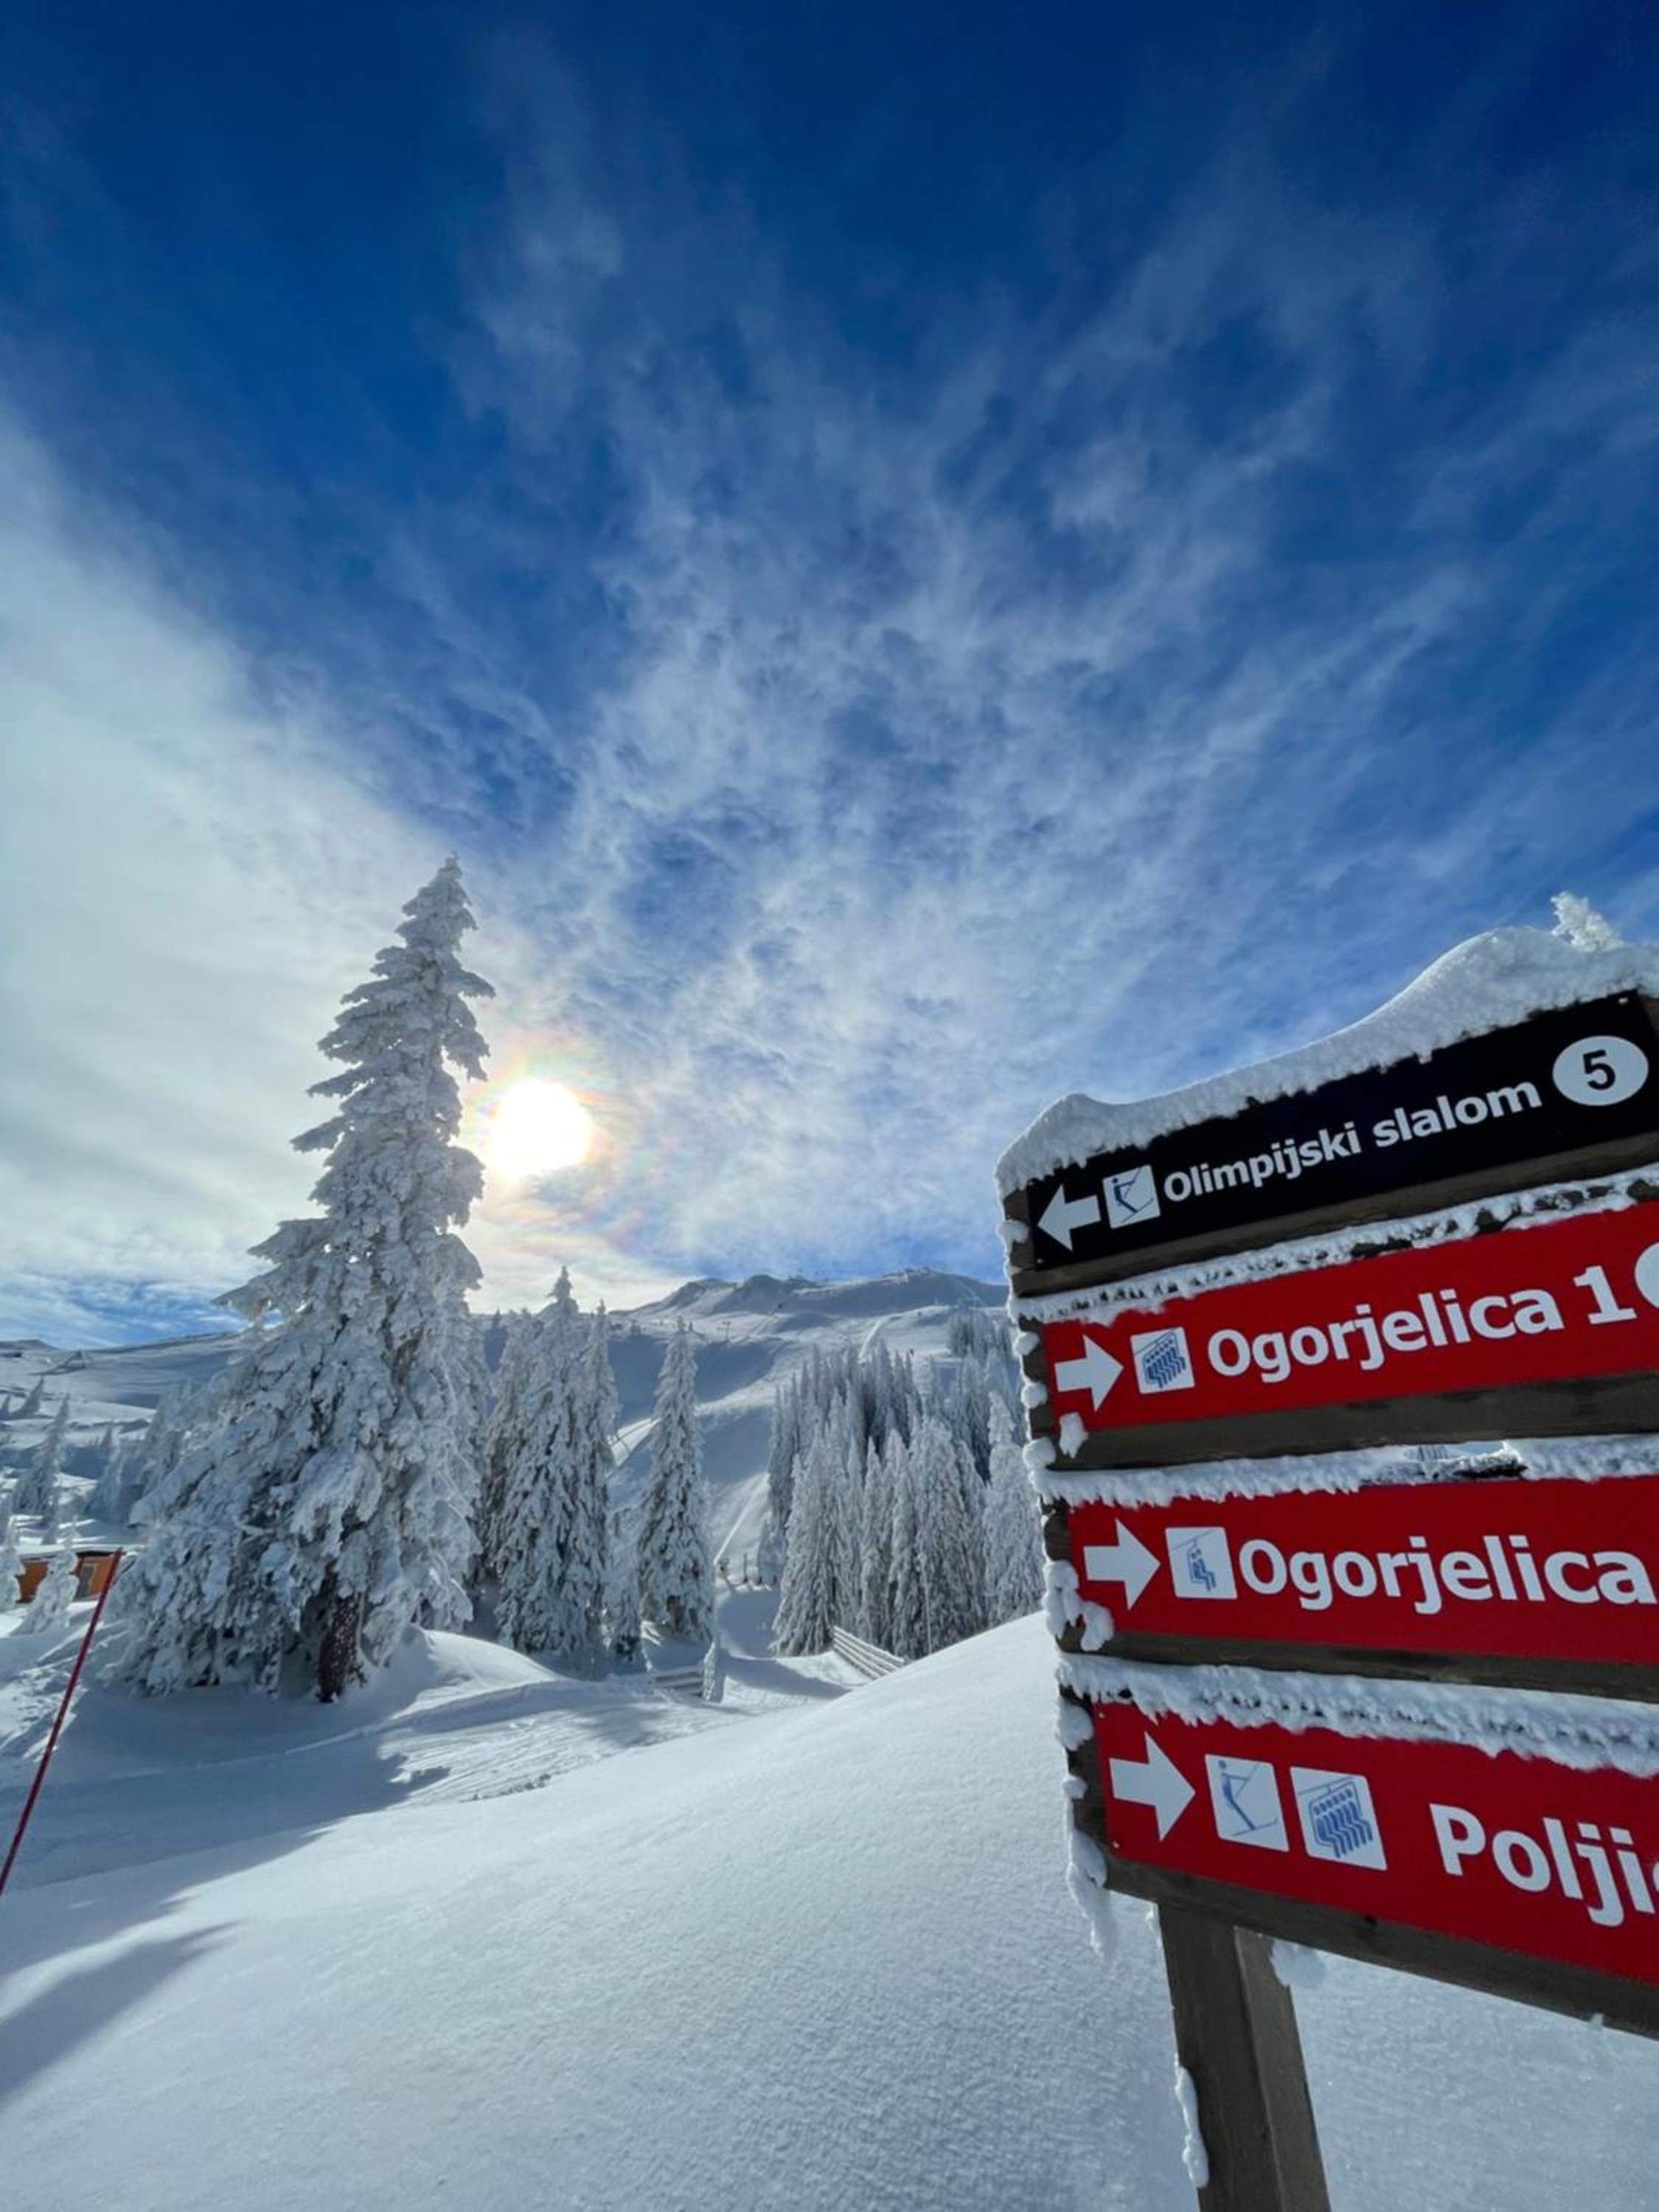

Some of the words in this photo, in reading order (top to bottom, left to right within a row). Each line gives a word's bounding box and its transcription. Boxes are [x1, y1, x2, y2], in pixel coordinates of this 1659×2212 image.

[1164, 1121, 1362, 1202] Olimpijski
[1373, 1082, 1543, 1149] slalom
[1582, 1049, 1616, 1091] 5
[1207, 1287, 1565, 1383] Ogorjelica
[1573, 1265, 1637, 1324] 1
[1239, 1534, 1658, 1615] Ogorjelica
[1429, 1803, 1659, 1927] Polji
